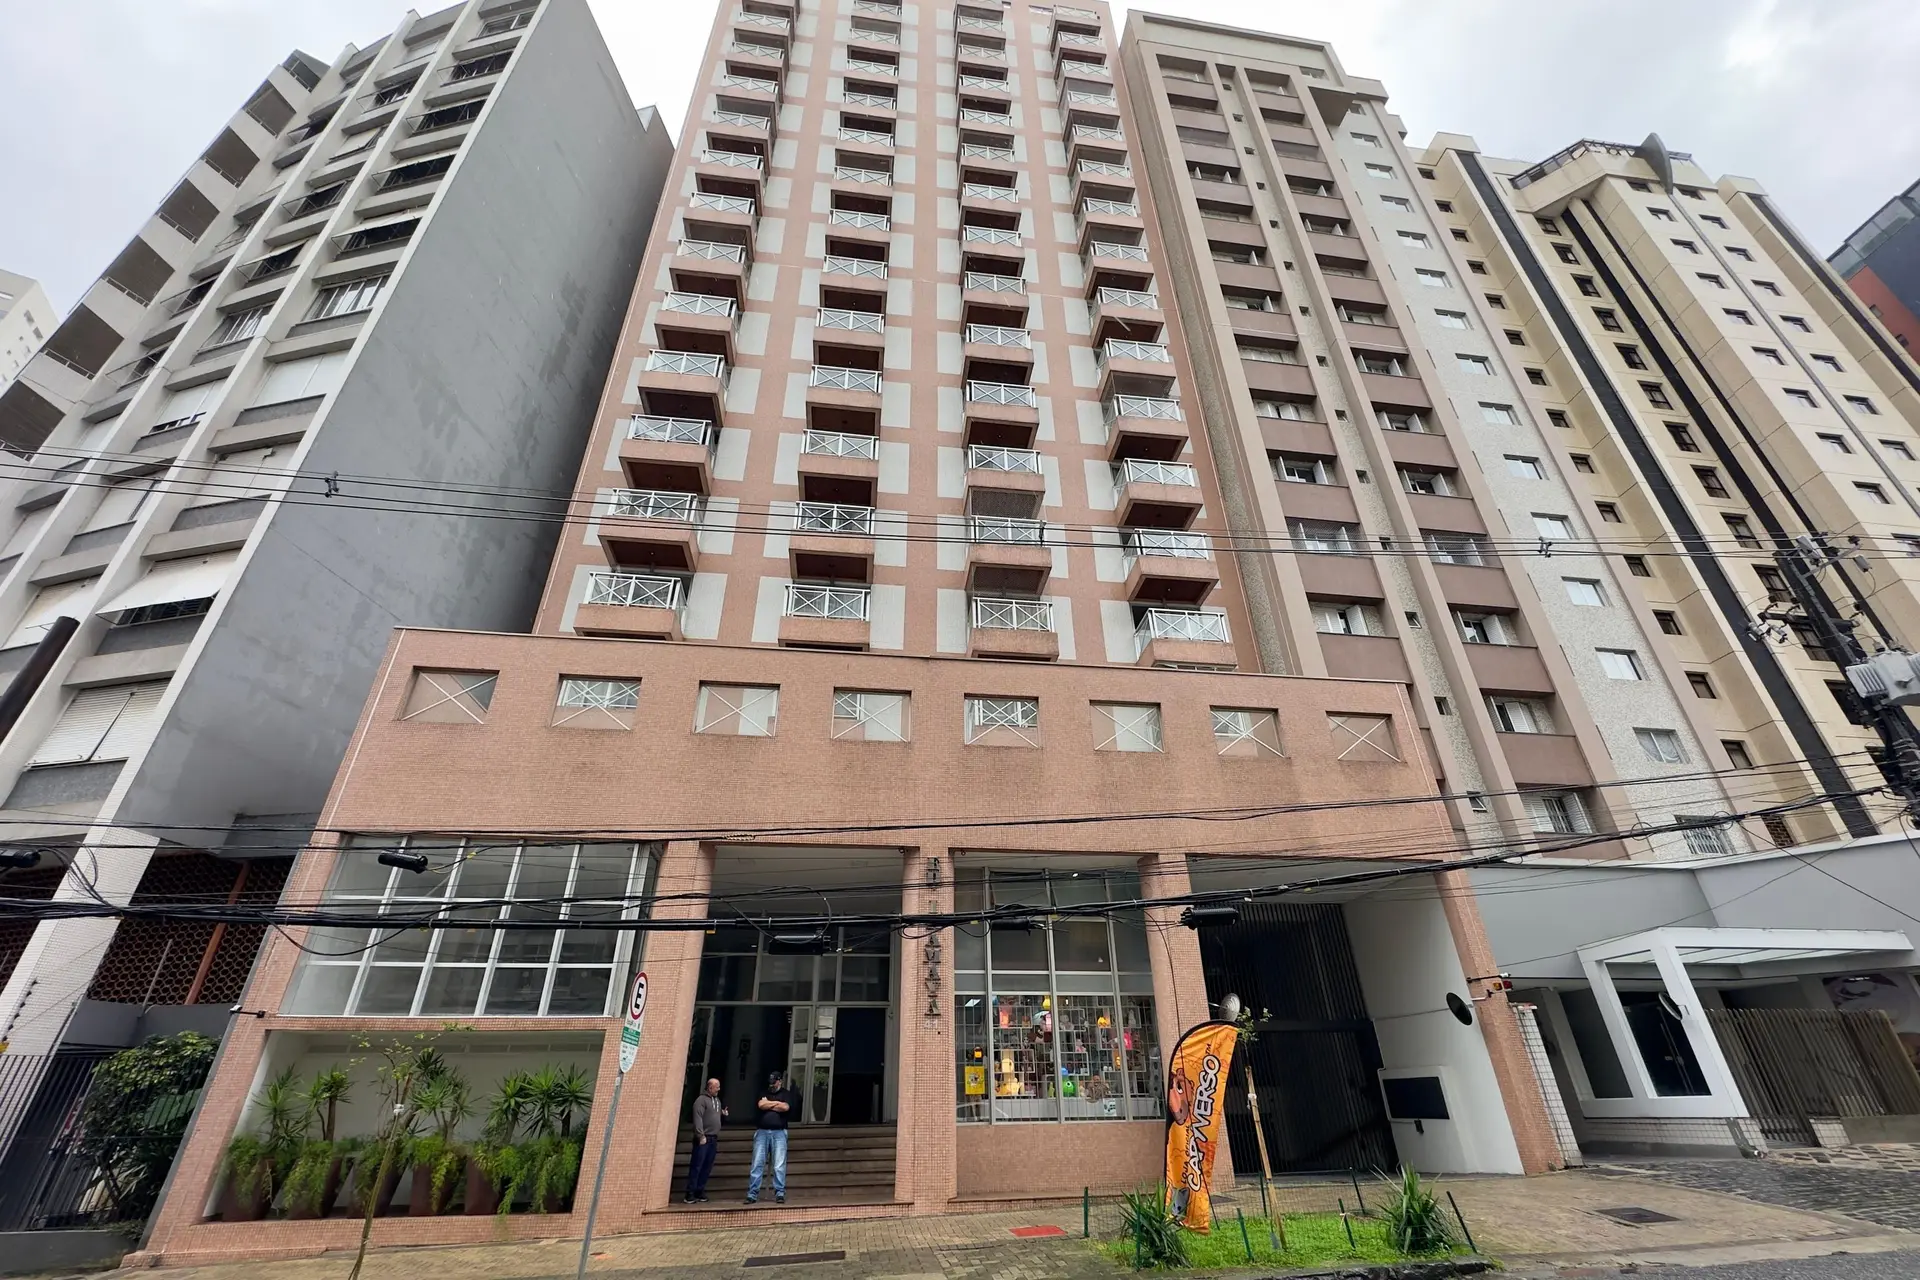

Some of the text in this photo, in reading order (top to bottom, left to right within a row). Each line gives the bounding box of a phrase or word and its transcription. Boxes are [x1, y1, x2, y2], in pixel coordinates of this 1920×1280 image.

[634, 982, 644, 1009] E
[1187, 1054, 1221, 1192] CAPYVERSO
[1181, 1162, 1189, 1184] LOJA
